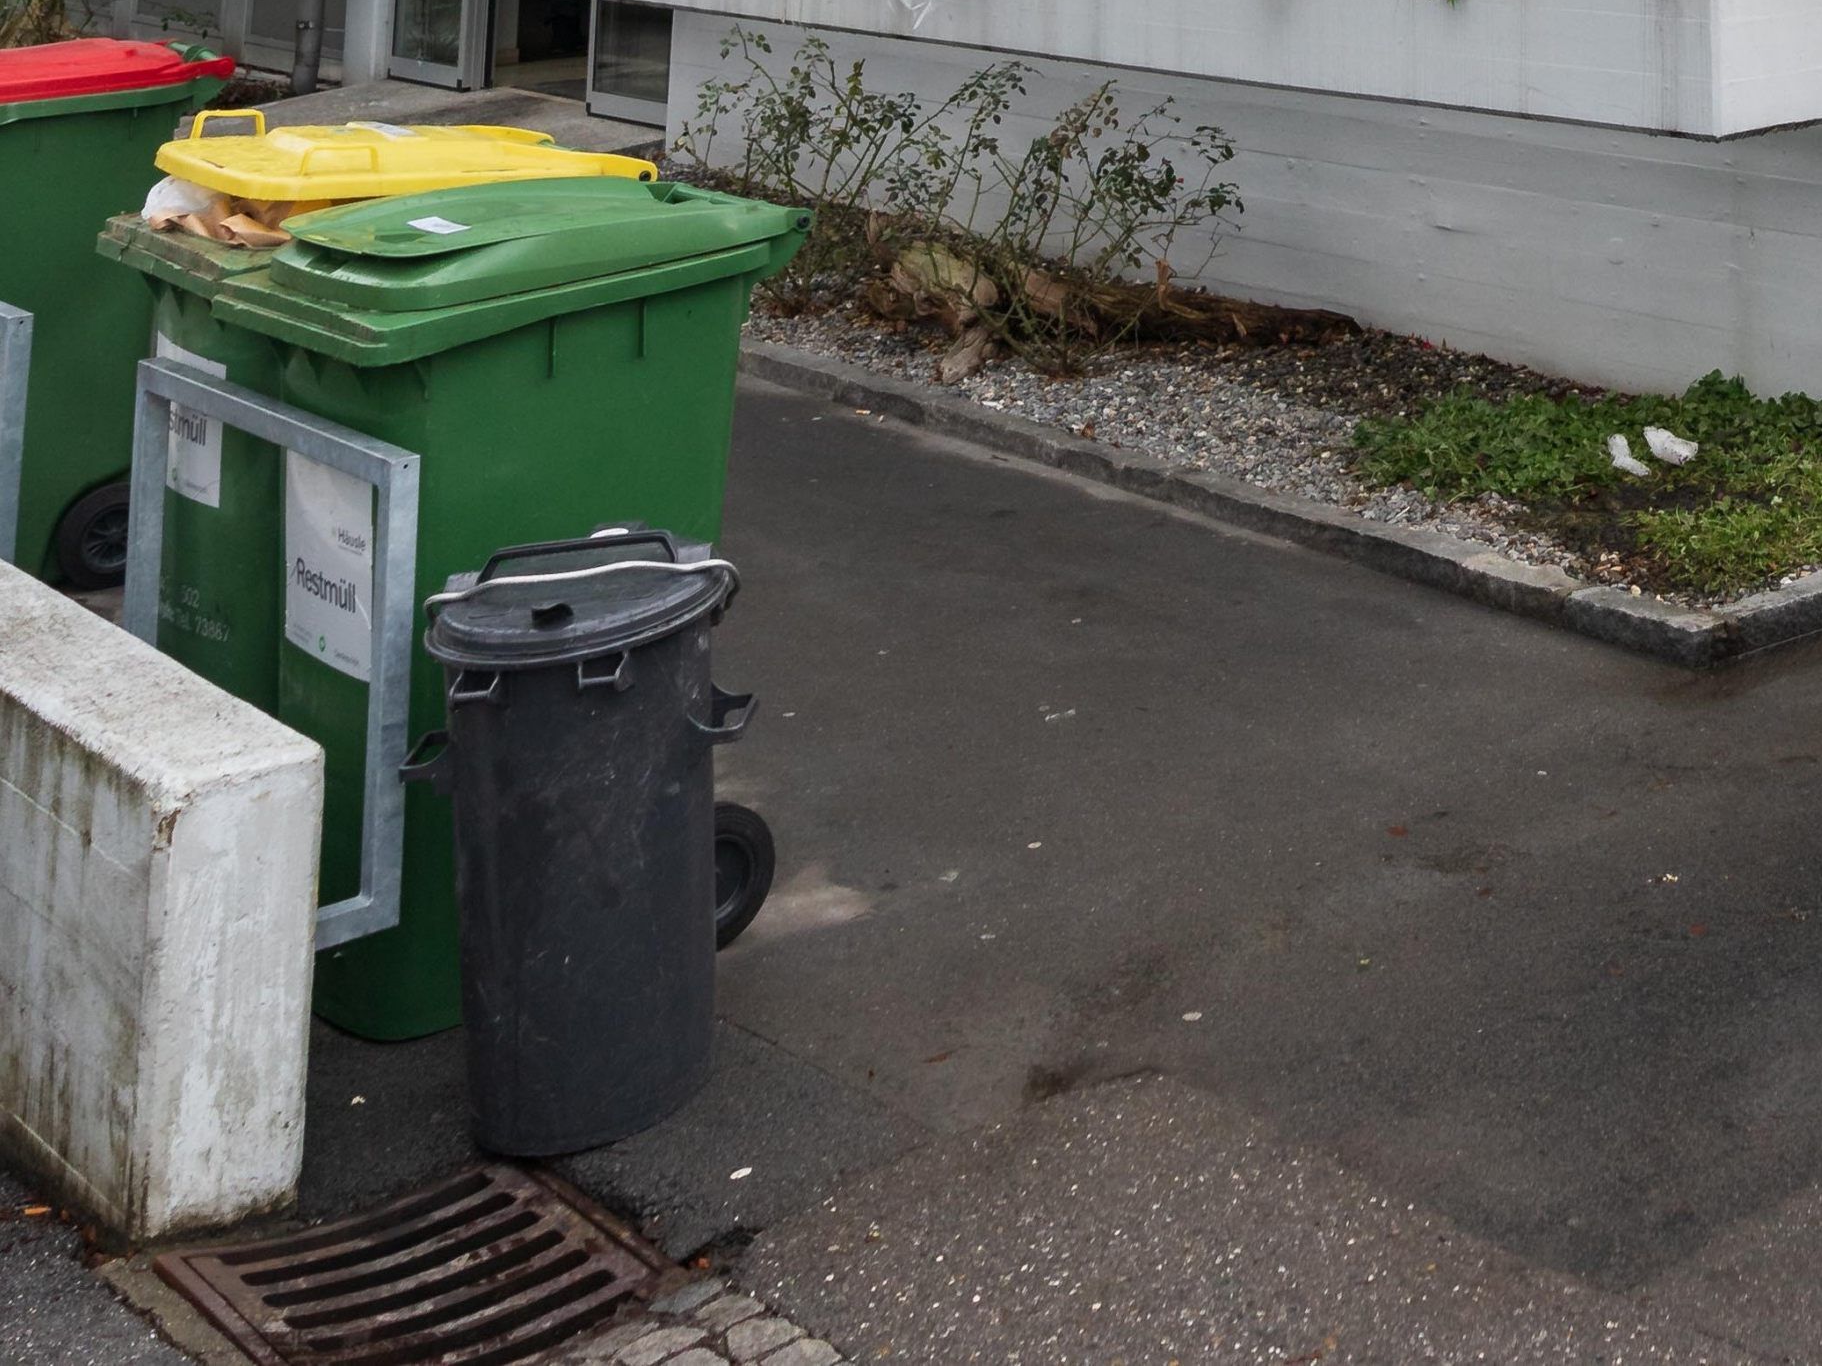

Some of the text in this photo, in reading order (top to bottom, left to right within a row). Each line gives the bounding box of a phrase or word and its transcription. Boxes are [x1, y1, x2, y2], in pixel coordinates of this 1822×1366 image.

[169, 408, 208, 447] stmüll
[337, 527, 366, 551] Häusle
[296, 557, 356, 614] Restmüll
